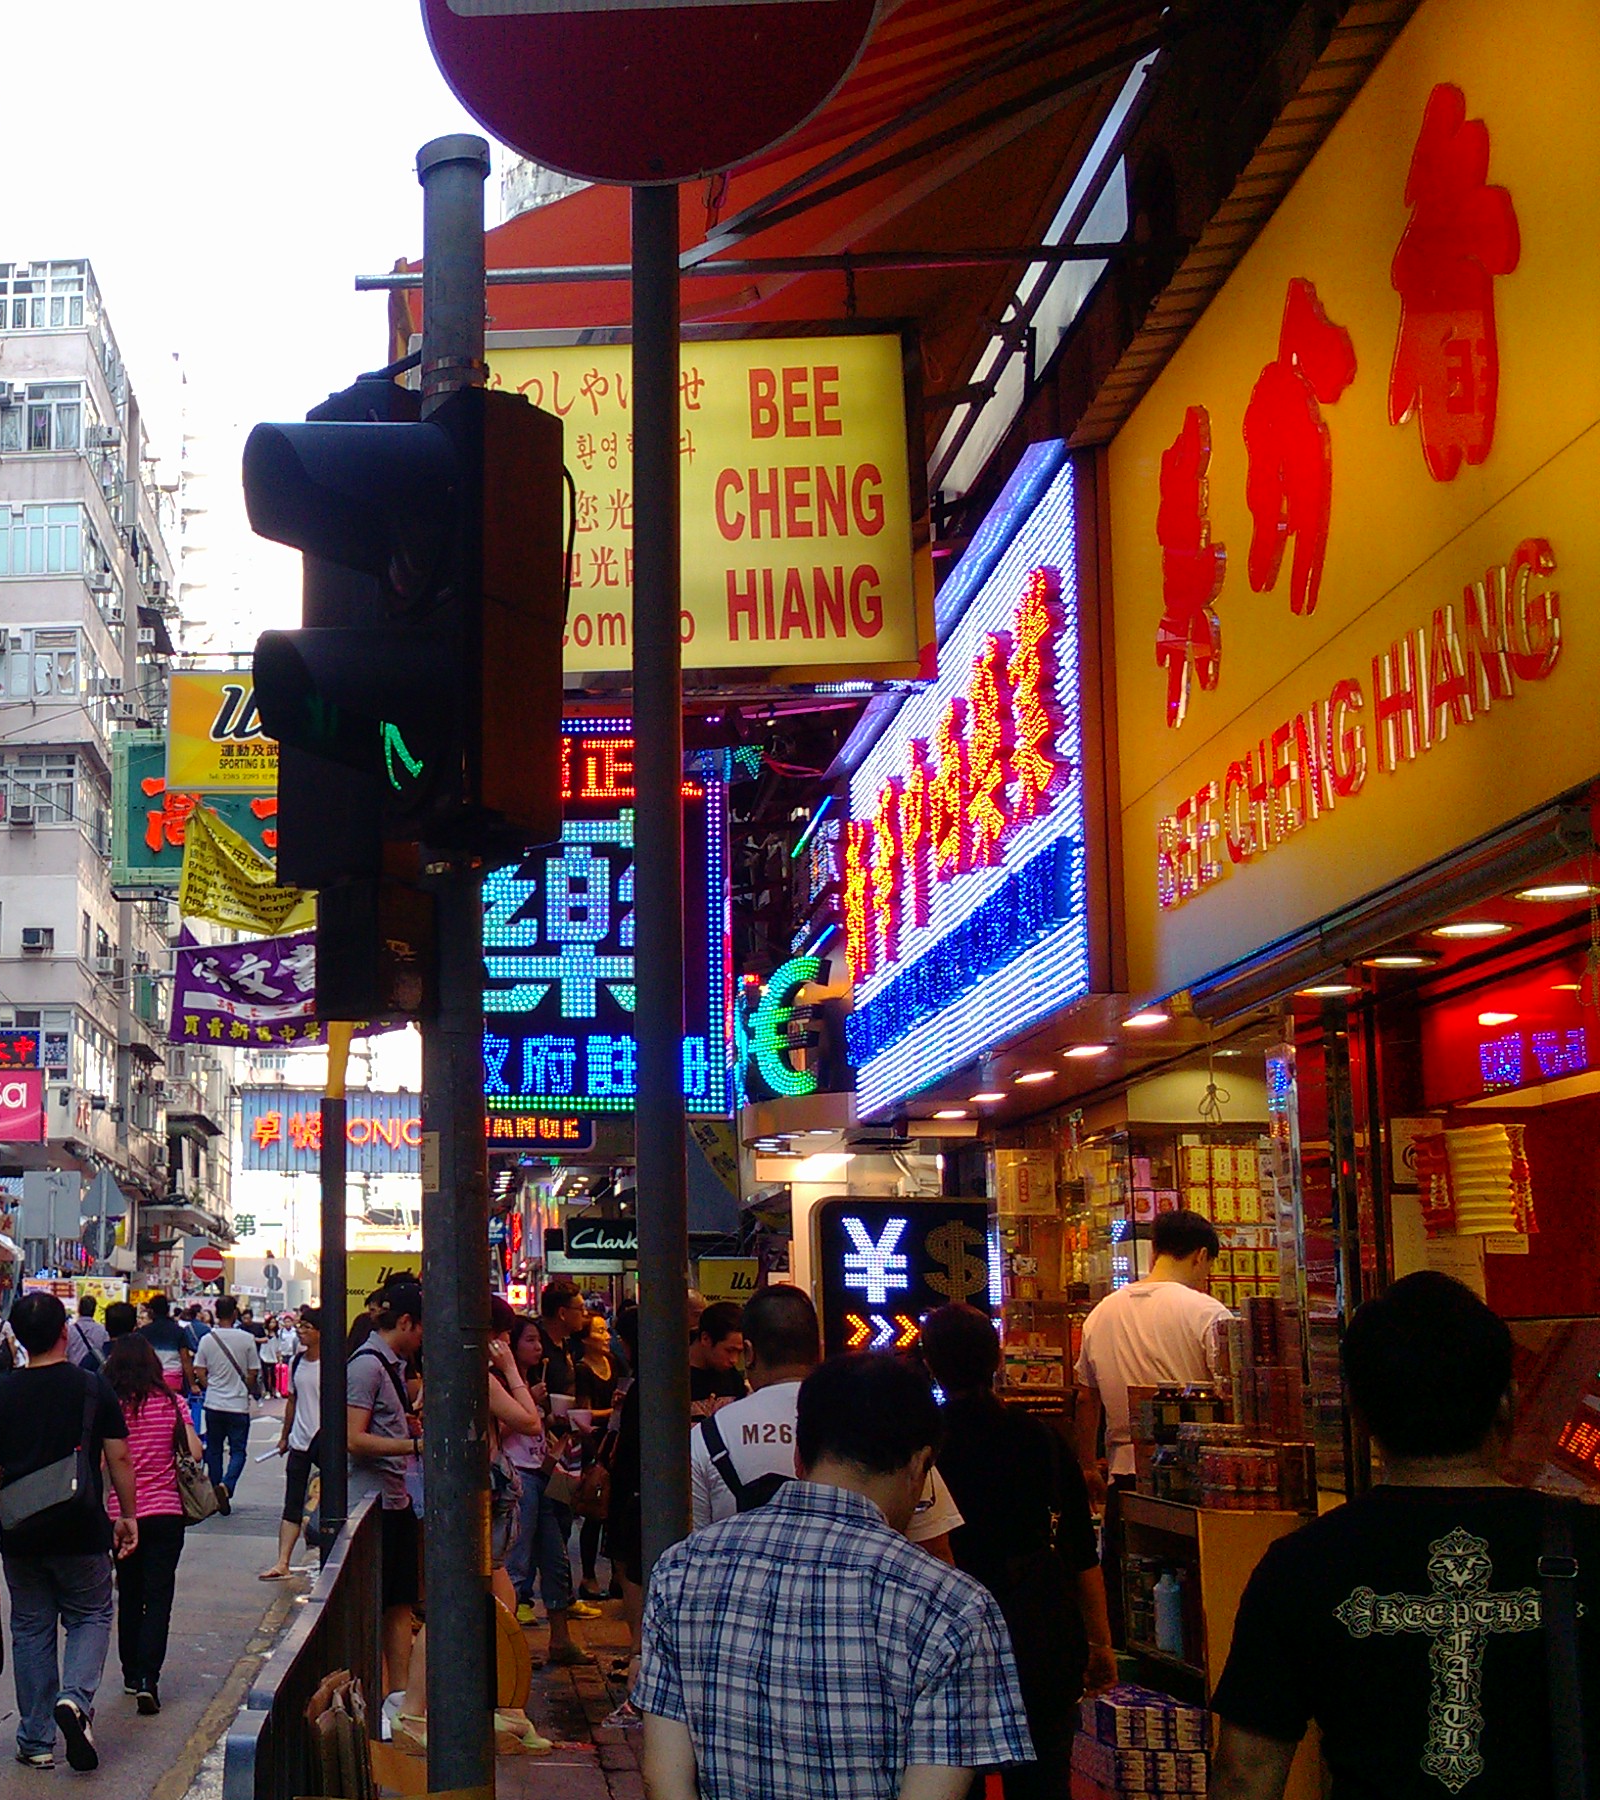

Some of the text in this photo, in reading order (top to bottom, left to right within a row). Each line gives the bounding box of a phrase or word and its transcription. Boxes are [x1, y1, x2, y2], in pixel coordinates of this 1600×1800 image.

[748, 365, 843, 440] BEE
[714, 462, 886, 541] CHENG
[725, 563, 884, 643] HIANG
[1157, 536, 1562, 912] BEE CHENG HIANG
[219, 758, 258, 769] SPORTING
[234, 1213, 283, 1237] 第一
[570, 1227, 639, 1250] Clark
